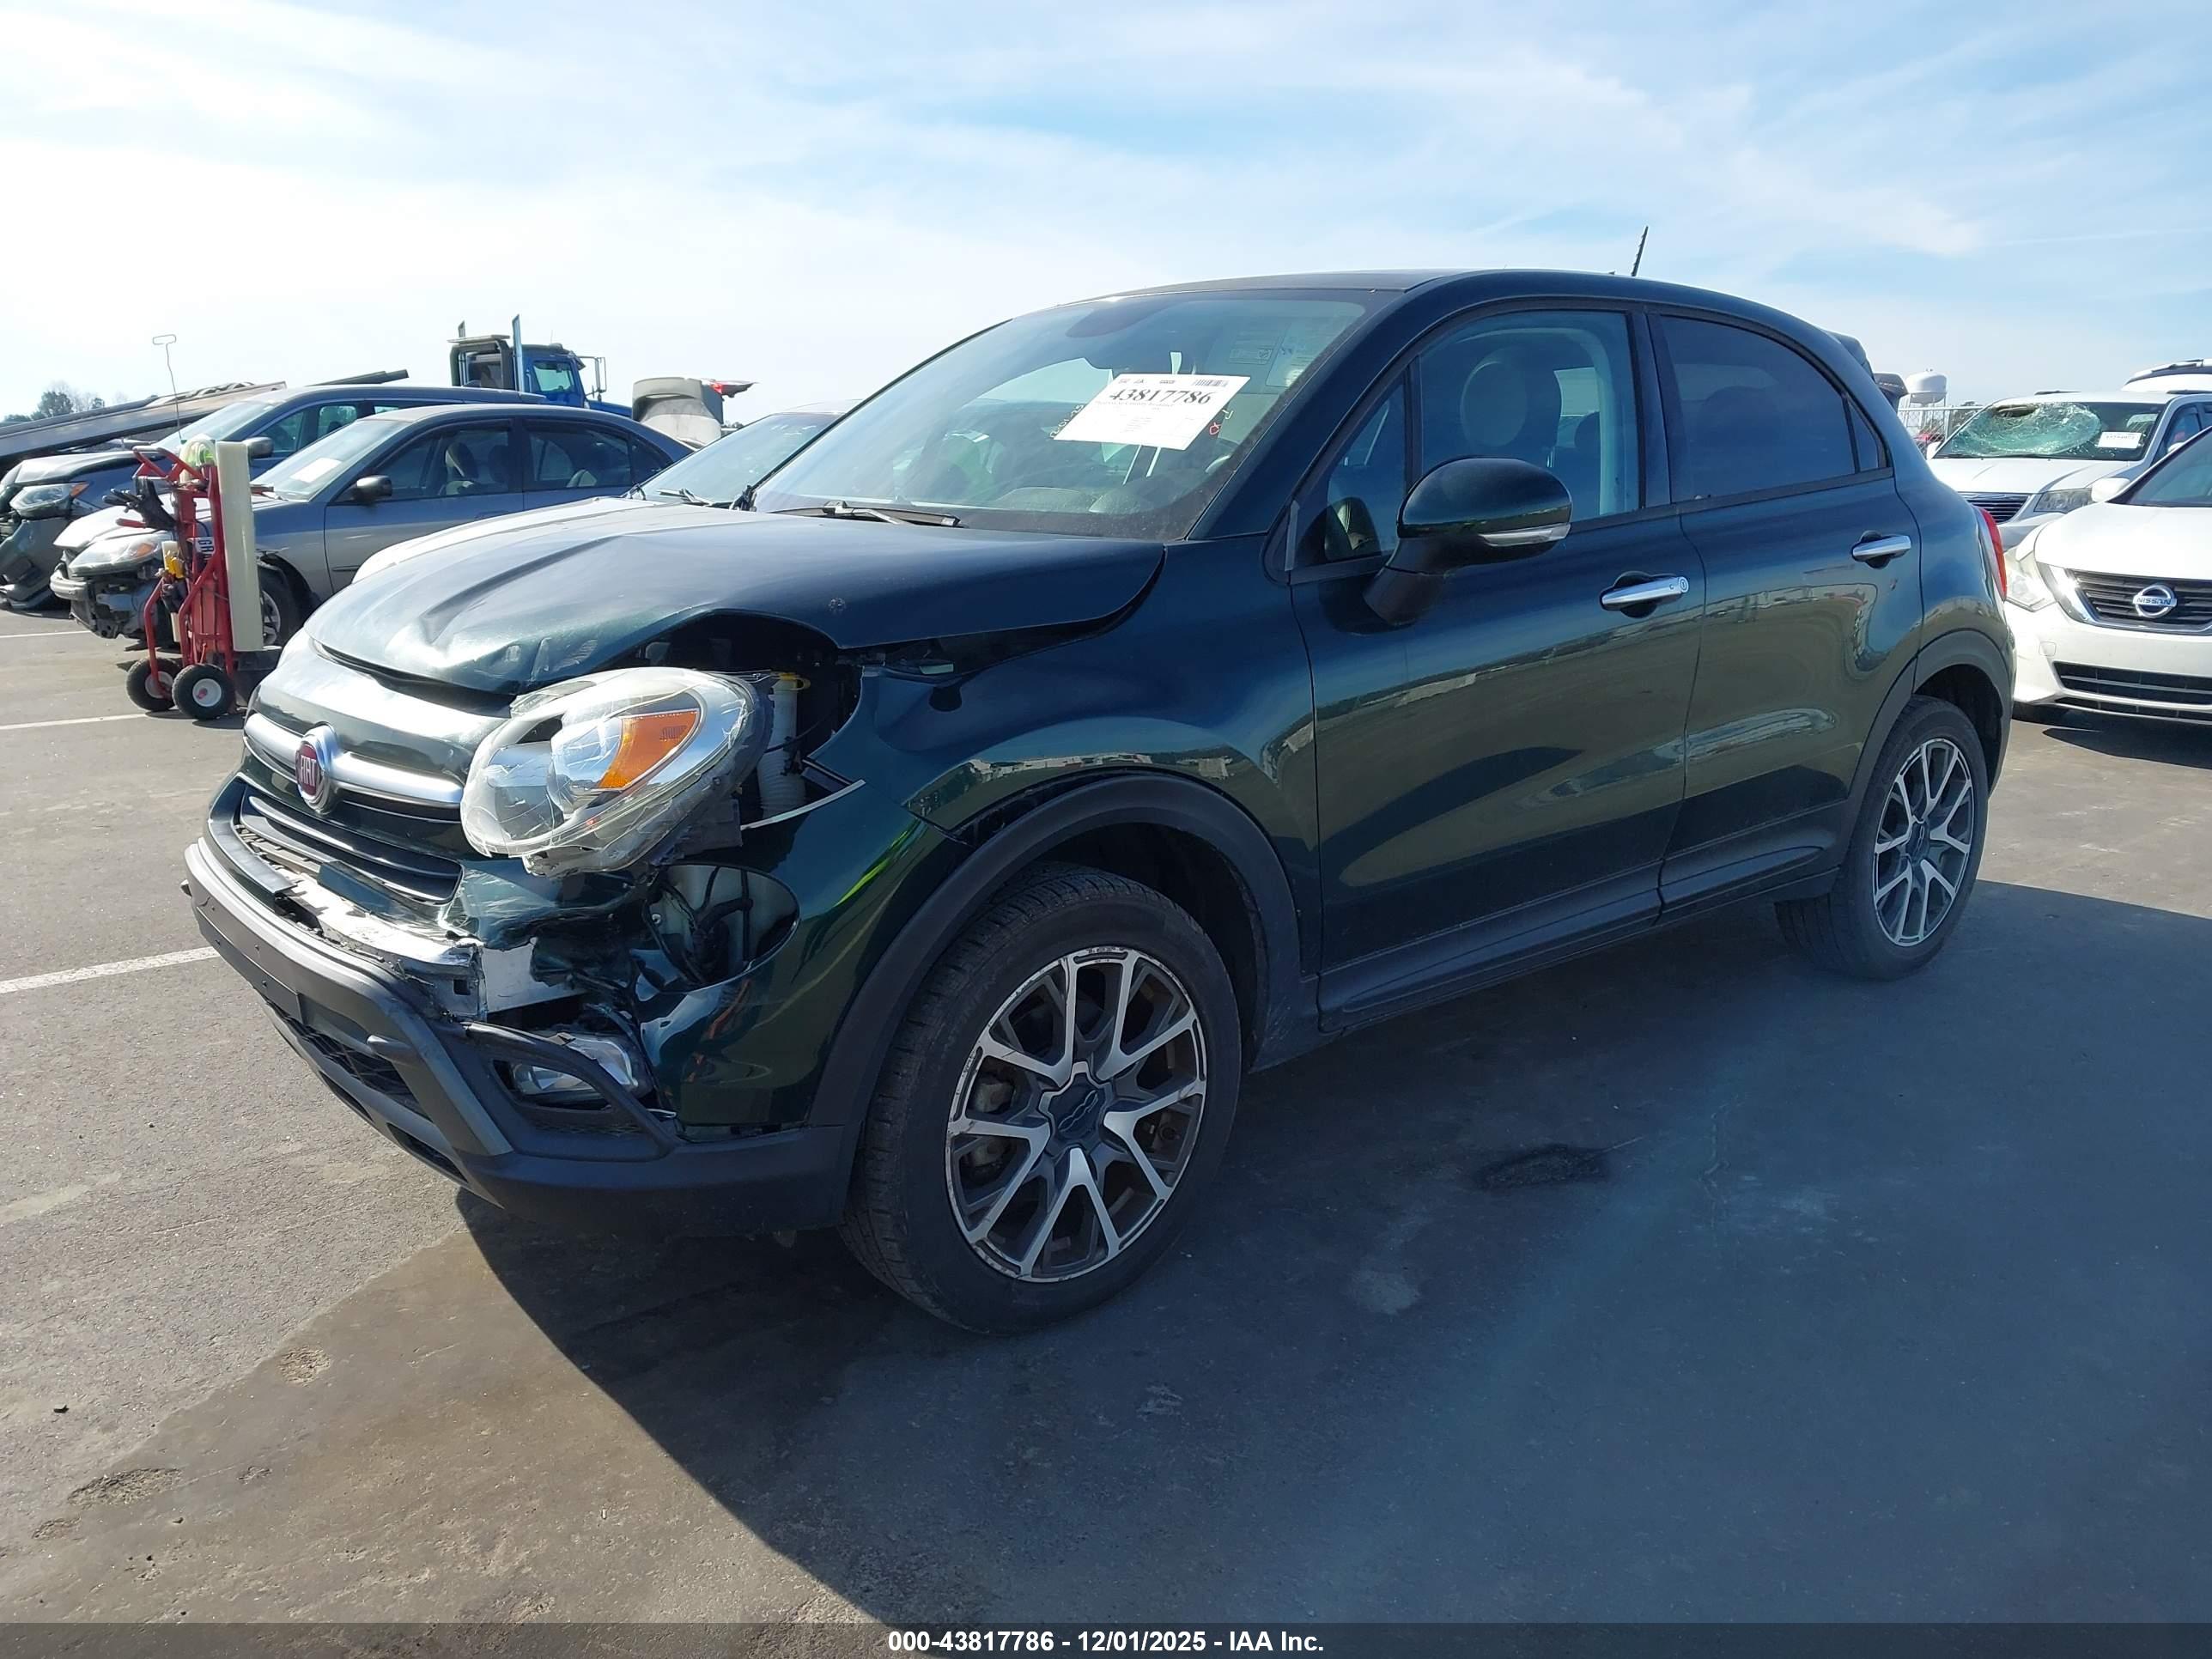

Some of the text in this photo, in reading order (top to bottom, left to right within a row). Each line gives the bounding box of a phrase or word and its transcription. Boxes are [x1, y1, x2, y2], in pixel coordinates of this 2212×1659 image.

[1109, 388, 1216, 404] 43817786
[2136, 597, 2172, 605] NISSAN
[300, 755, 317, 787] FIAT
